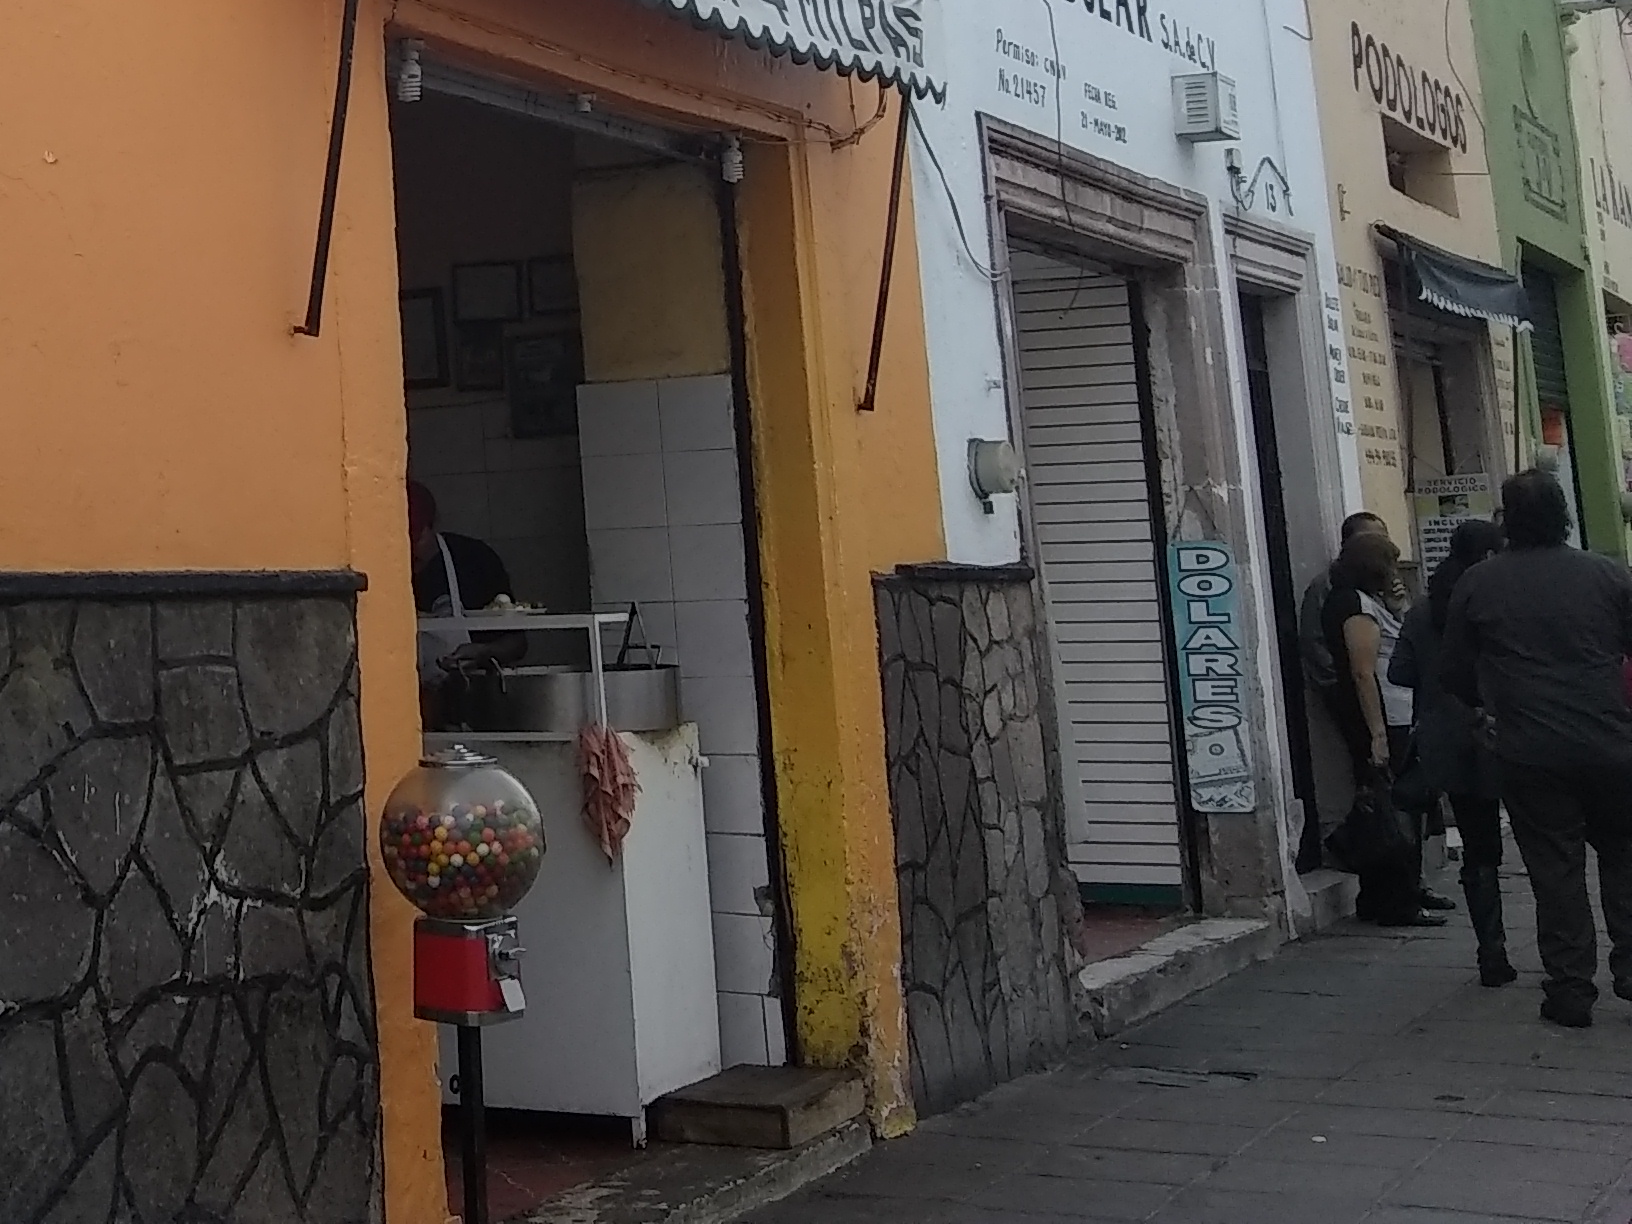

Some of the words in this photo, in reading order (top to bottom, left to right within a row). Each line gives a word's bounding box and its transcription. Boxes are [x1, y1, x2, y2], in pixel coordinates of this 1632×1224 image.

[1012, 73, 1047, 108] 21457
[1351, 20, 1467, 154] PODOLOGOS
[1417, 484, 1488, 495] PODOLOGICO
[1426, 477, 1477, 487] SERVICIO
[1428, 518, 1468, 527] INCLU
[1176, 546, 1244, 730] DOLARES
